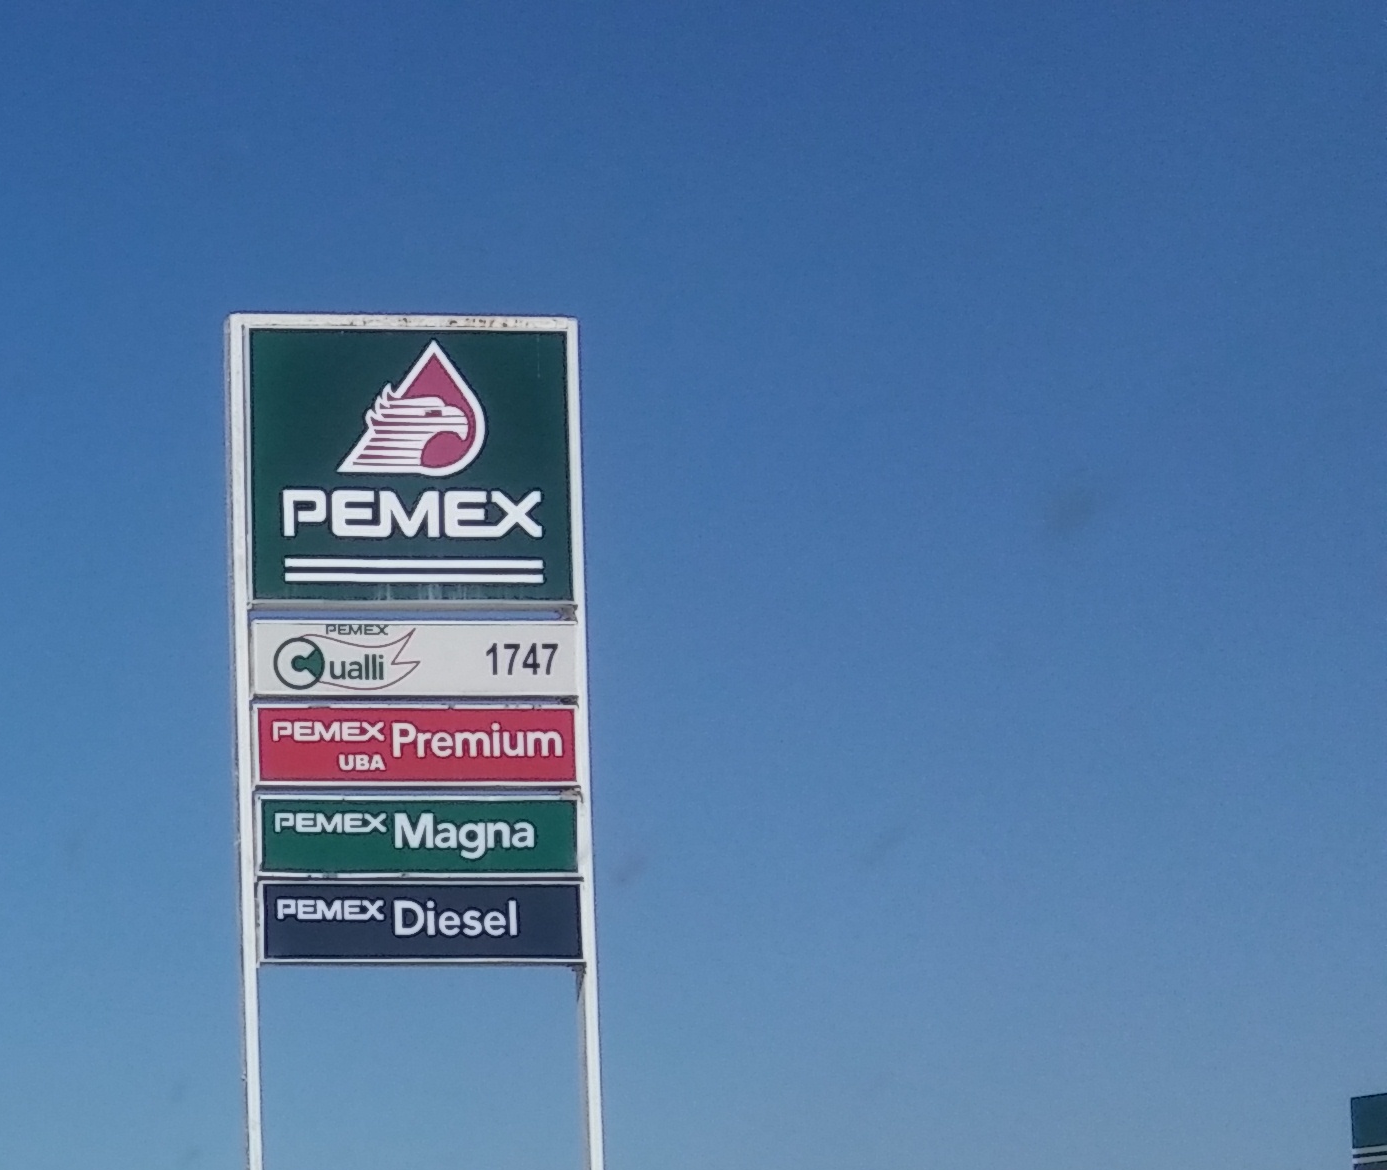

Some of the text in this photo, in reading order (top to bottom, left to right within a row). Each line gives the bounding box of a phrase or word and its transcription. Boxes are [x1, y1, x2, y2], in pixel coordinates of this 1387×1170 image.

[282, 489, 543, 538] PEMEX
[325, 624, 389, 636] PEMEX
[486, 643, 559, 676] 1747
[272, 721, 564, 758] PEMEX Premium
[338, 754, 386, 771] UBA
[274, 812, 535, 860] PEMEX Magna
[276, 899, 519, 937] PEMEX Diesel
